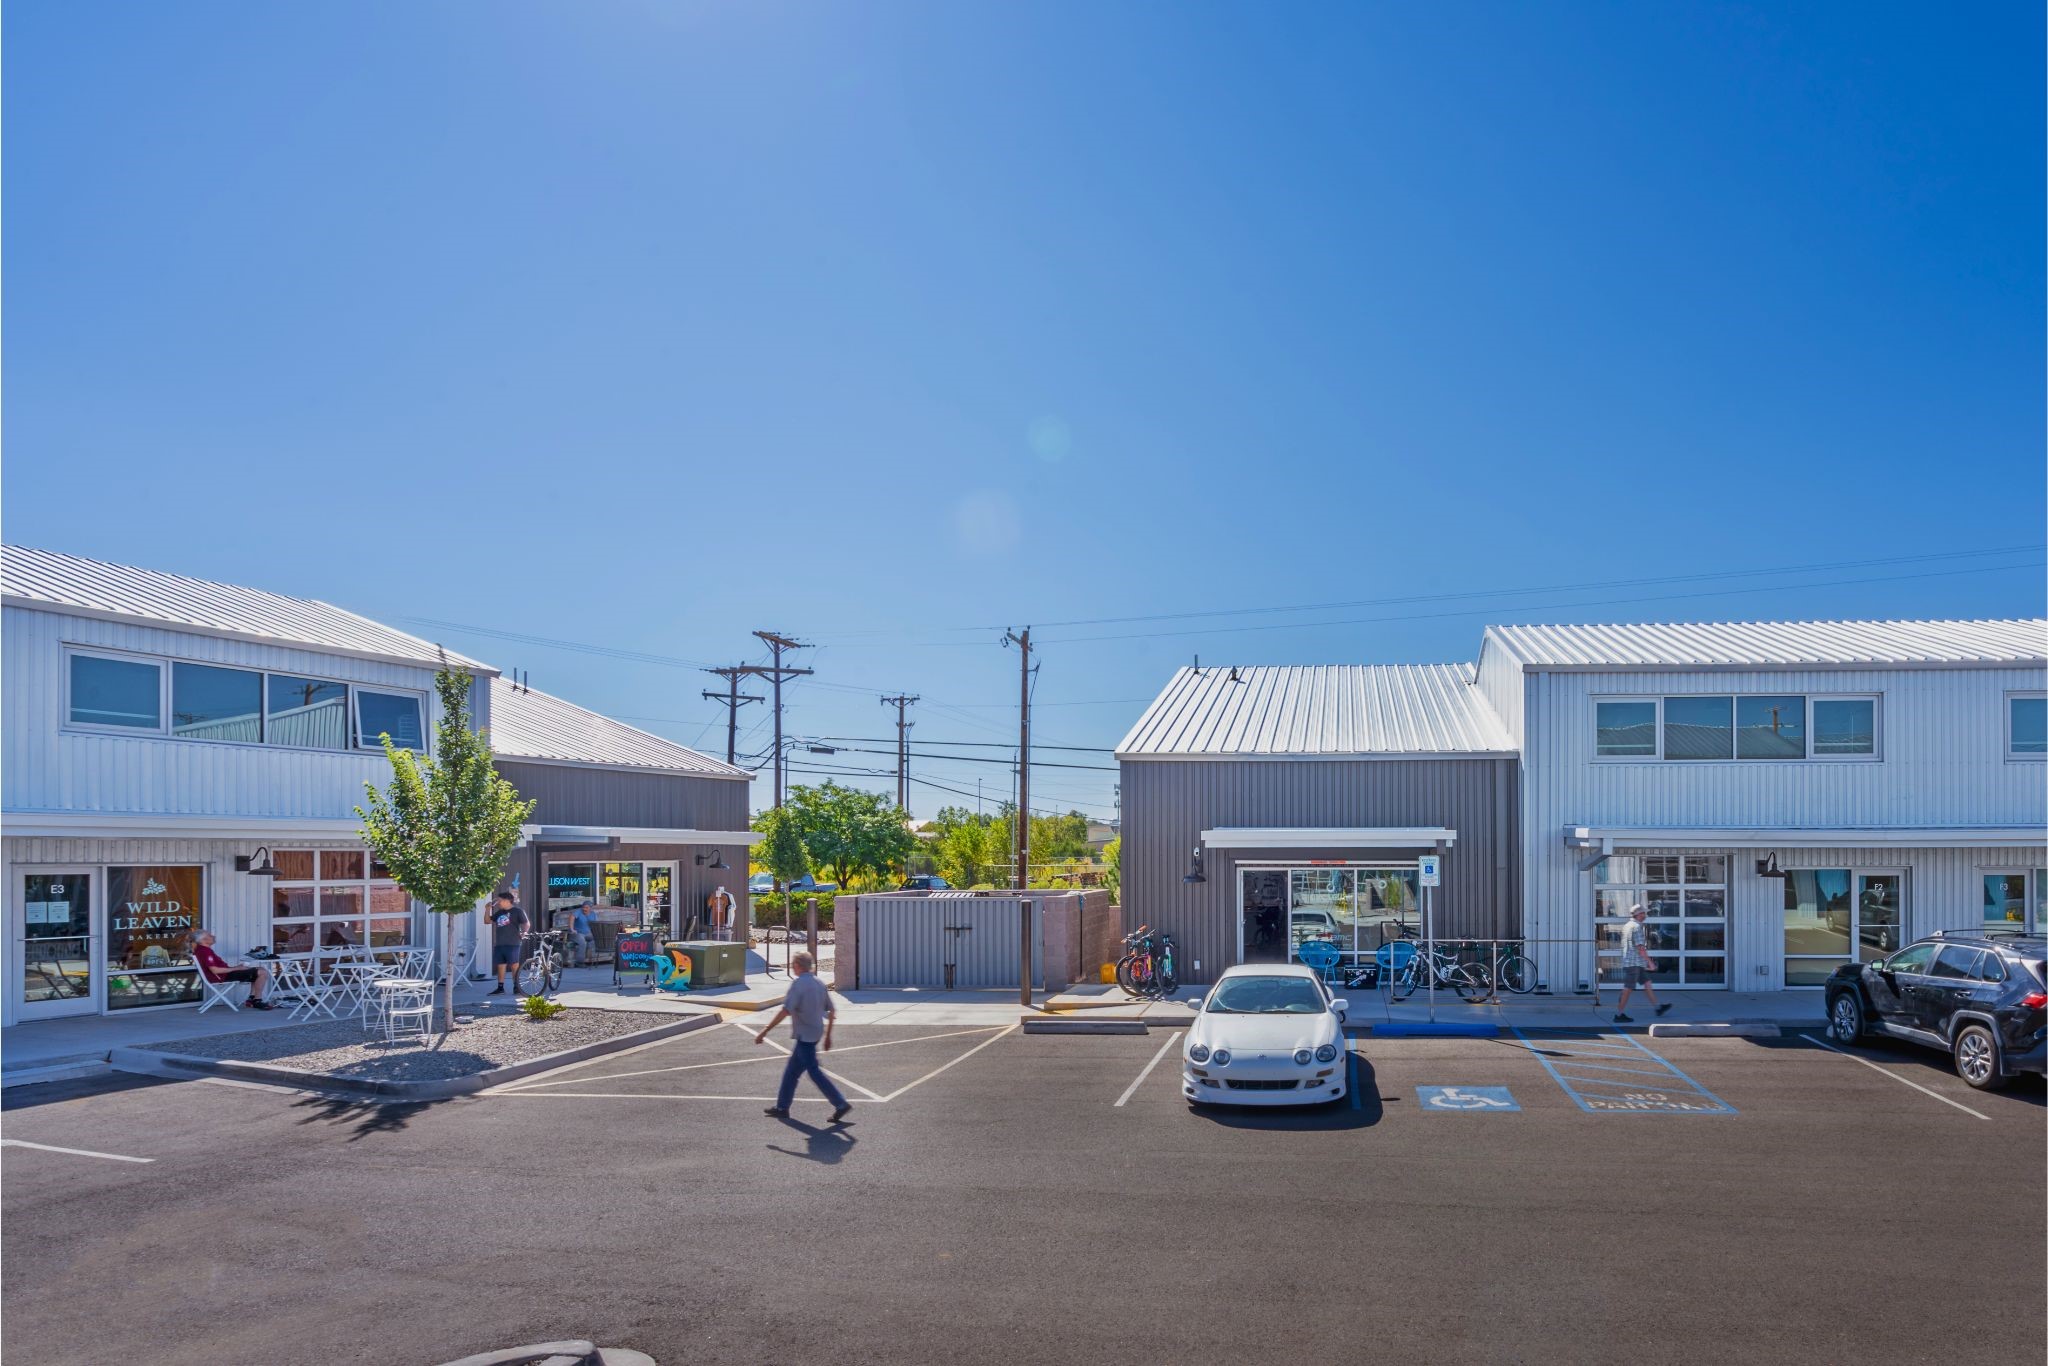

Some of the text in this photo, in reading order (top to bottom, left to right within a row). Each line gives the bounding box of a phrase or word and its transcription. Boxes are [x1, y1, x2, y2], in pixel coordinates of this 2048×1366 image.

[570, 877, 591, 885] WEST
[50, 884, 65, 894] E3
[1874, 883, 1883, 891] F2
[1999, 883, 2009, 891] F3
[126, 900, 181, 914] WILD
[114, 915, 193, 930] LEAVEN
[128, 932, 177, 941] BAKERY
[620, 941, 649, 952] OPEN
[1624, 1093, 1667, 1101] NO
